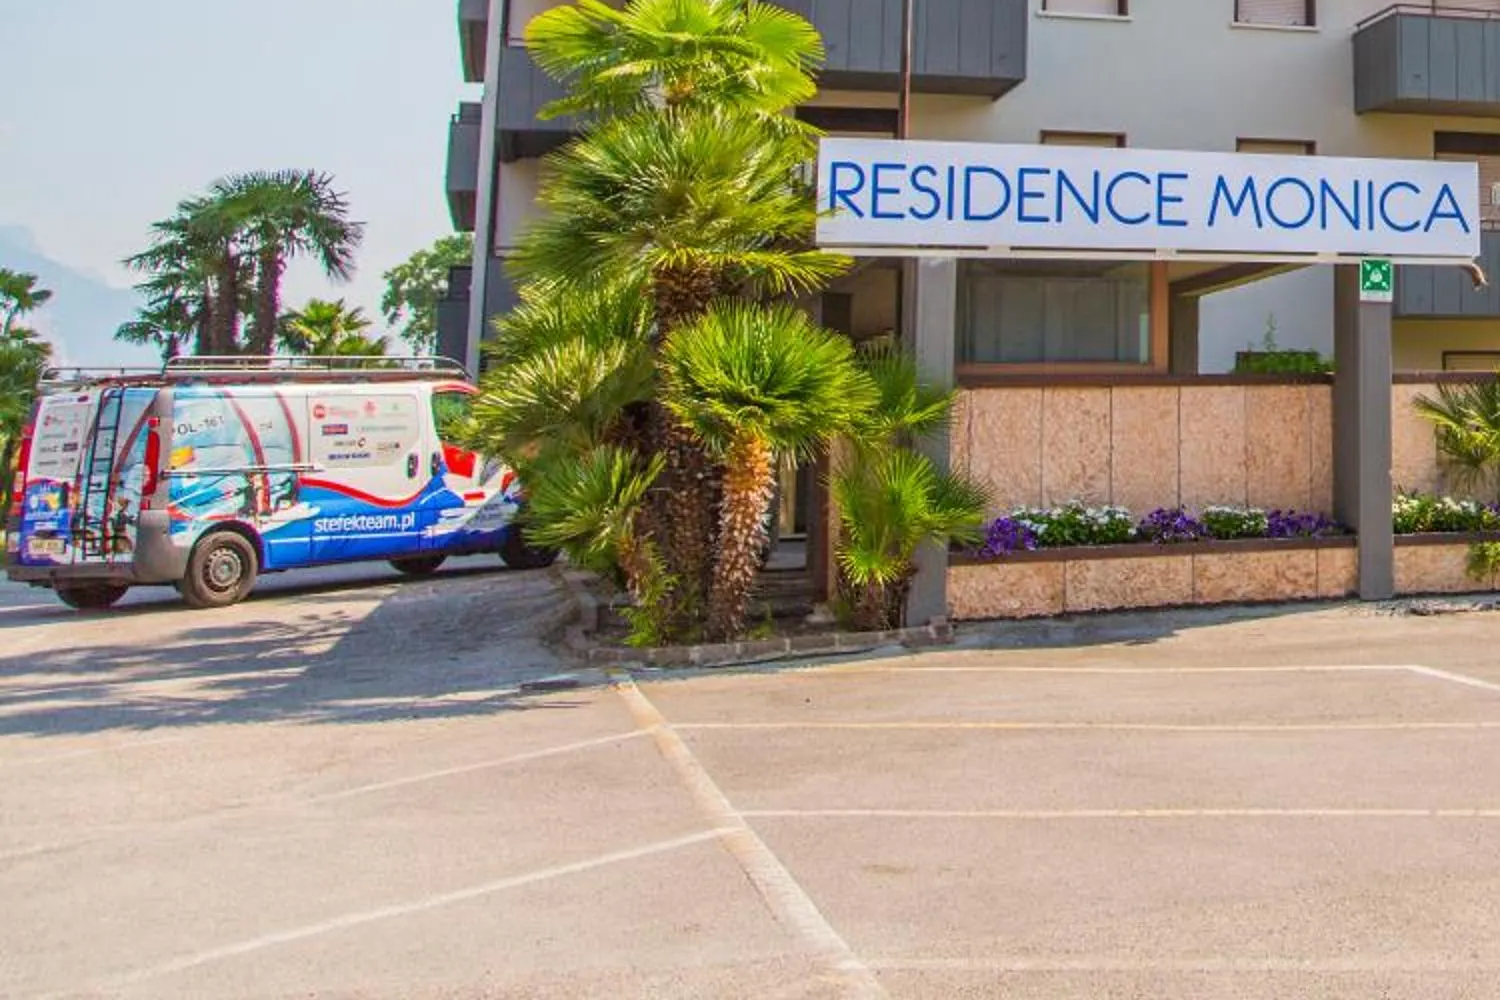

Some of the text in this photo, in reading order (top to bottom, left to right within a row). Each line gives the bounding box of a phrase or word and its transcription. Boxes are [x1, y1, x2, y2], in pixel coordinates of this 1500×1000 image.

[829, 161, 1470, 235] RESIDENCE MONICA
[314, 511, 415, 533] stefekteam.pl
